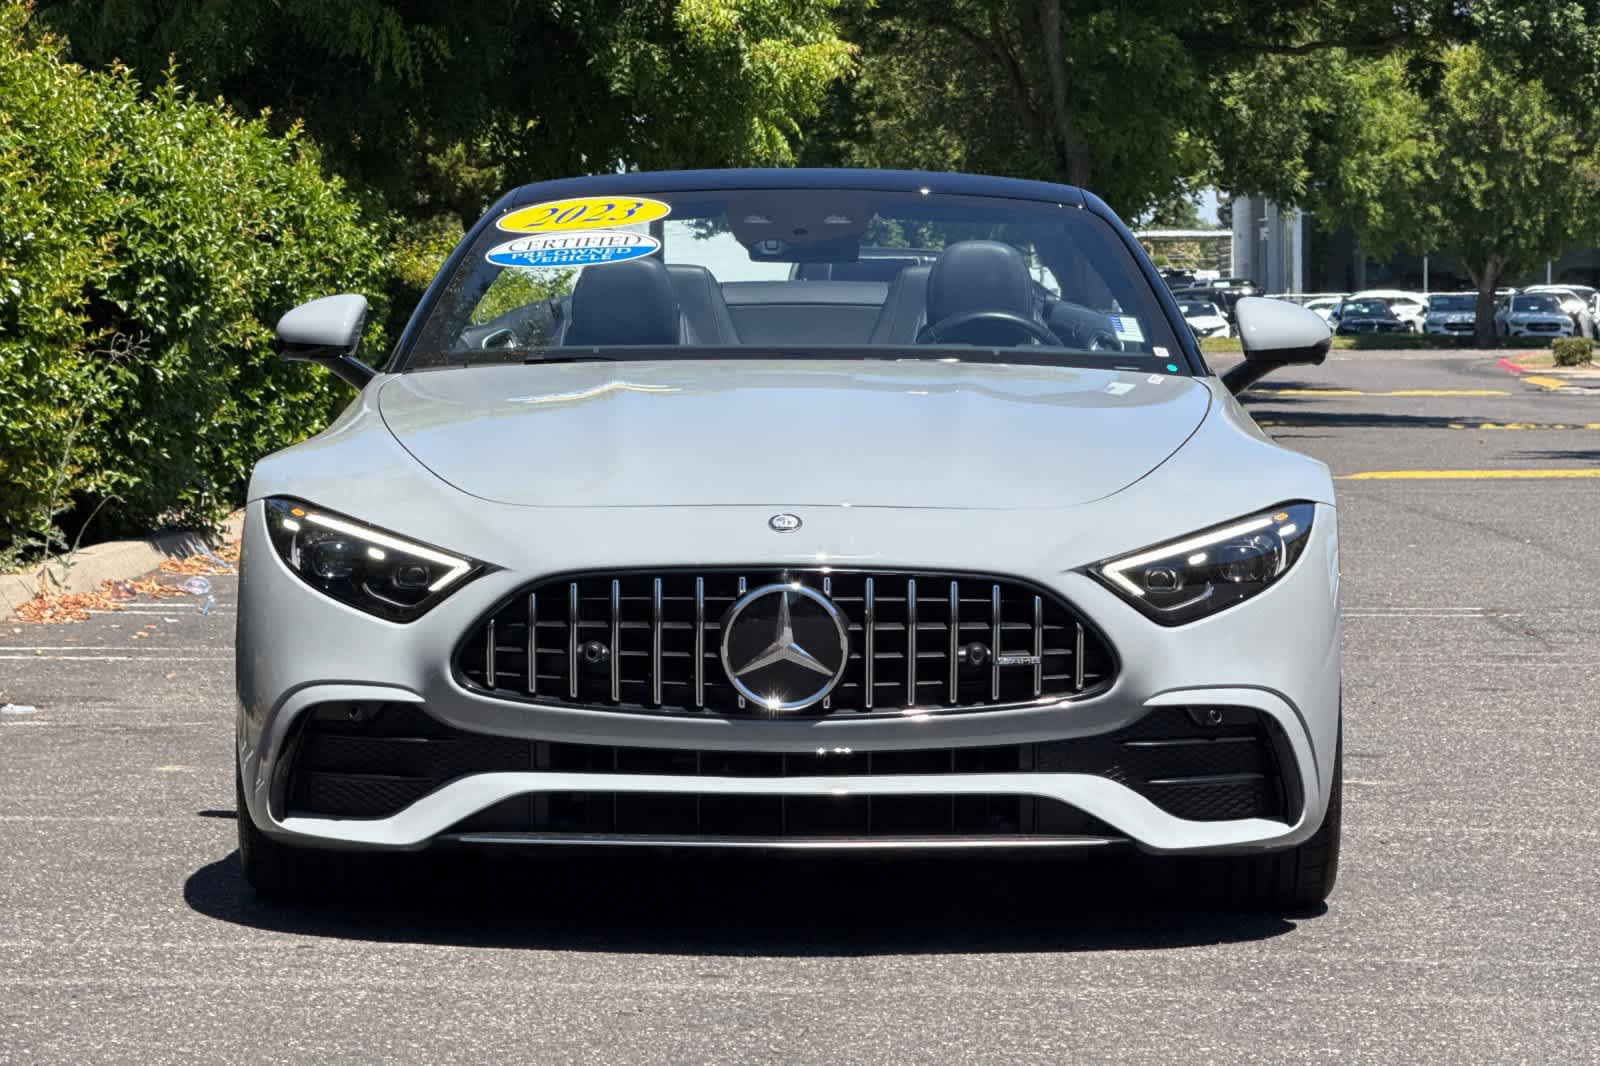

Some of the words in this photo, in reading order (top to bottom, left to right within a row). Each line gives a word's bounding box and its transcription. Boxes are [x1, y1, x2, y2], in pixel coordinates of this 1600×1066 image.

[522, 202, 643, 228] 2023
[509, 236, 642, 251] CERTIFIED
[511, 247, 632, 260] PRE-OWNED
[528, 253, 613, 264] VEHICLE
